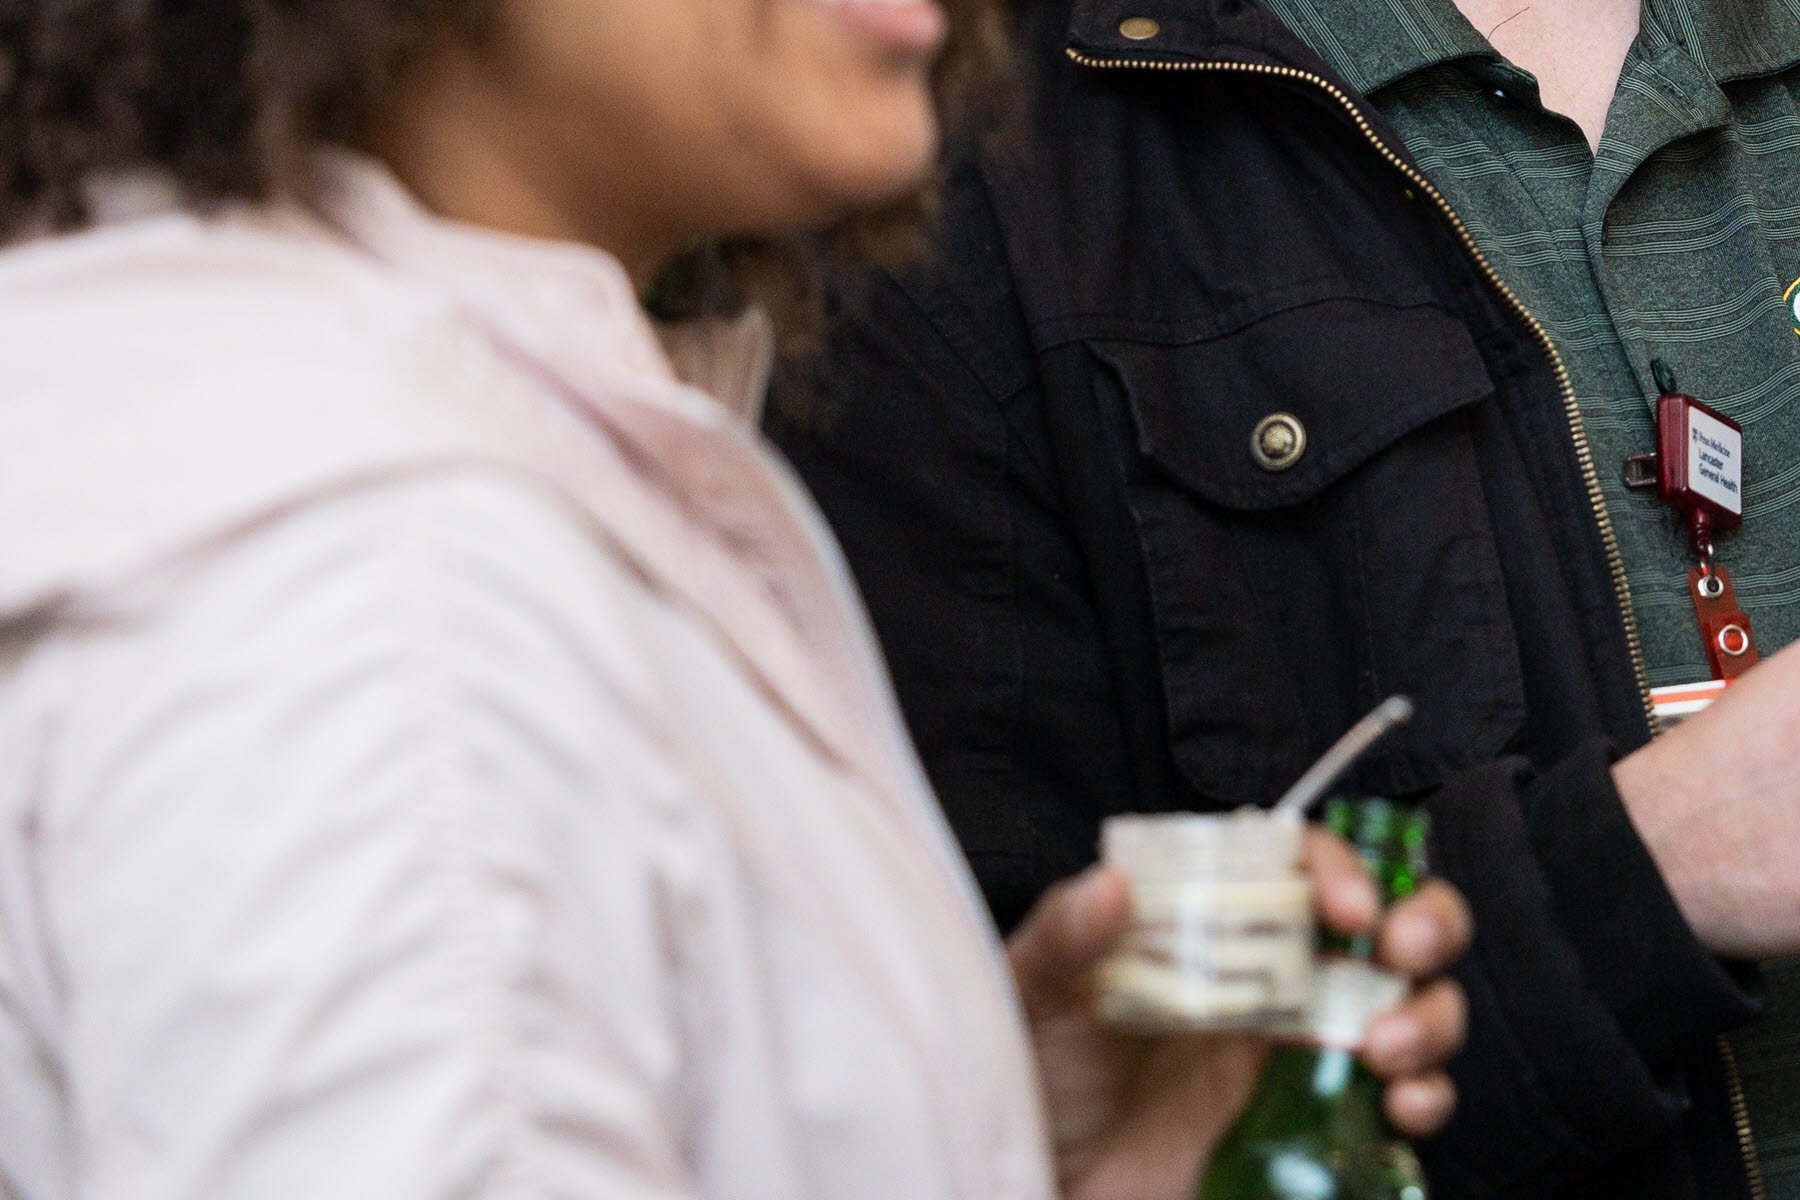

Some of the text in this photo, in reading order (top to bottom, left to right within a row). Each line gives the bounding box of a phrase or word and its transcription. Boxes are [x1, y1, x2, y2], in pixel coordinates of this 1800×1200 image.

[1699, 447, 1723, 470] Lancaster
[1710, 438, 1731, 458] Medicine
[1699, 462, 1738, 494] General Health
